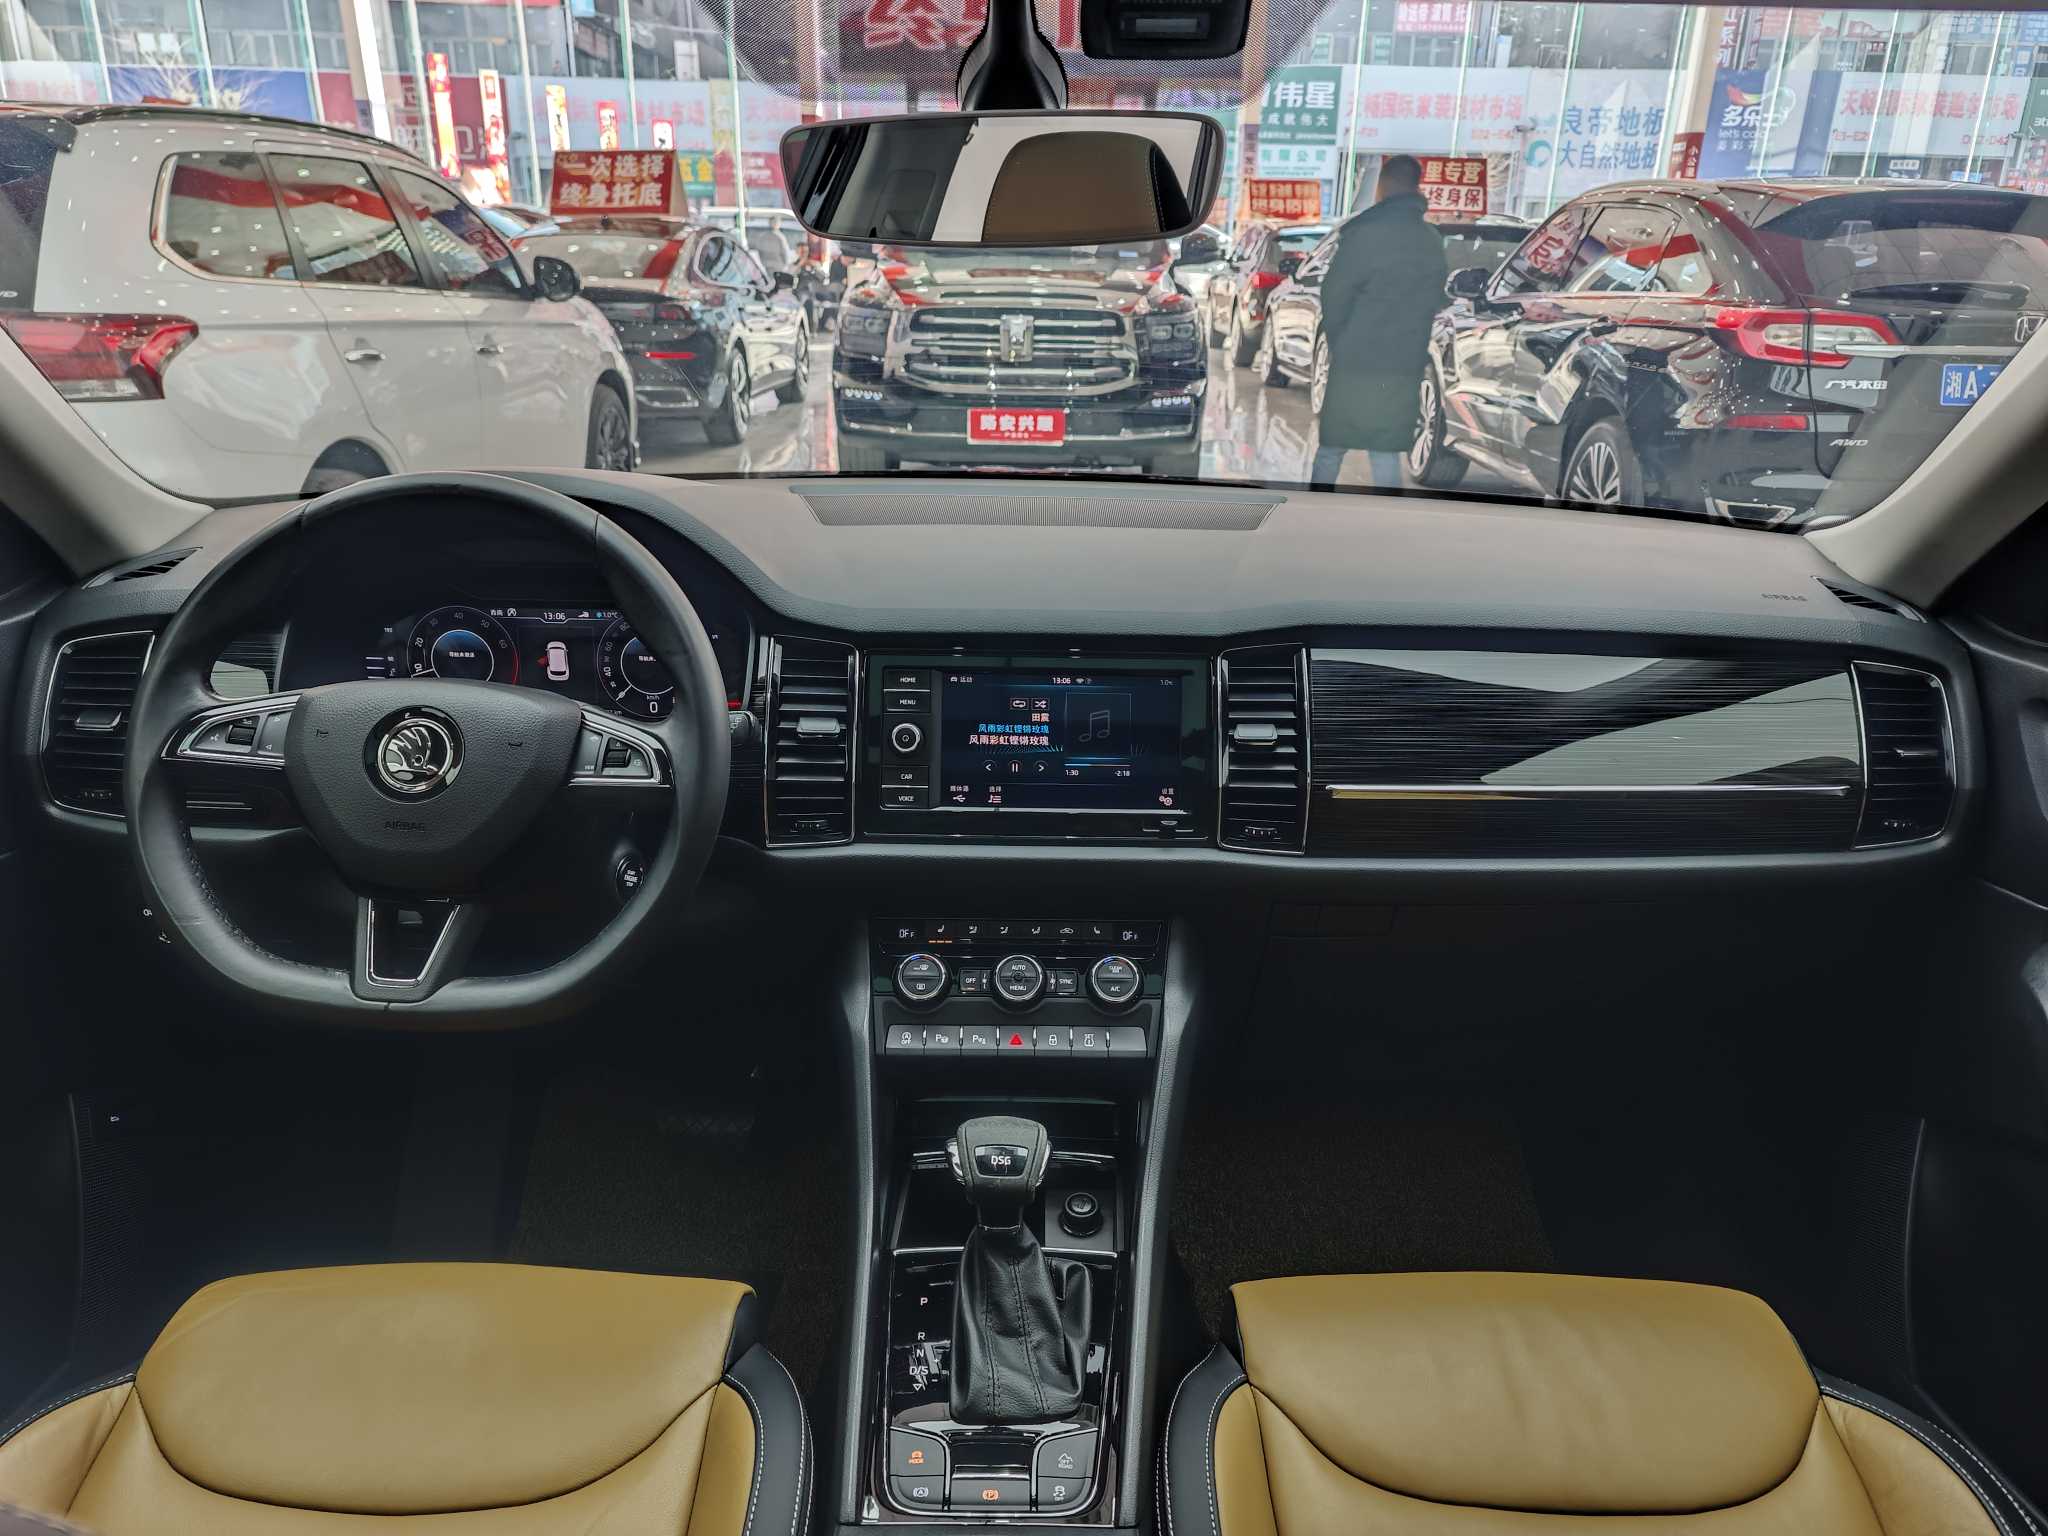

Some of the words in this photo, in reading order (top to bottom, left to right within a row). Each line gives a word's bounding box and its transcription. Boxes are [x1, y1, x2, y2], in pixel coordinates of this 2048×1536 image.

[1273, 80, 1336, 109] 伟星
[1559, 140, 1659, 171] 大自然地板
[562, 154, 665, 179] 一次选择
[560, 181, 663, 207] 终身托底
[1421, 187, 1482, 208] 终身保
[1825, 379, 1888, 391] 广汽本田
[1945, 369, 1998, 400] 湘A
[1829, 438, 1869, 447] AWD
[544, 612, 566, 620] 13:06
[649, 702, 659, 714] 0
[1031, 713, 1050, 722] 田震
[978, 724, 1050, 734] 风雨彩虹铿锵玫瑰
[968, 735, 1049, 746] 风雨彩虹铿锵玫瑰
[991, 1155, 1011, 1166] DSG
[920, 1297, 928, 1306] P
[918, 1331, 926, 1341] R
[916, 1348, 924, 1358] N
[909, 1365, 929, 1376] D/S
